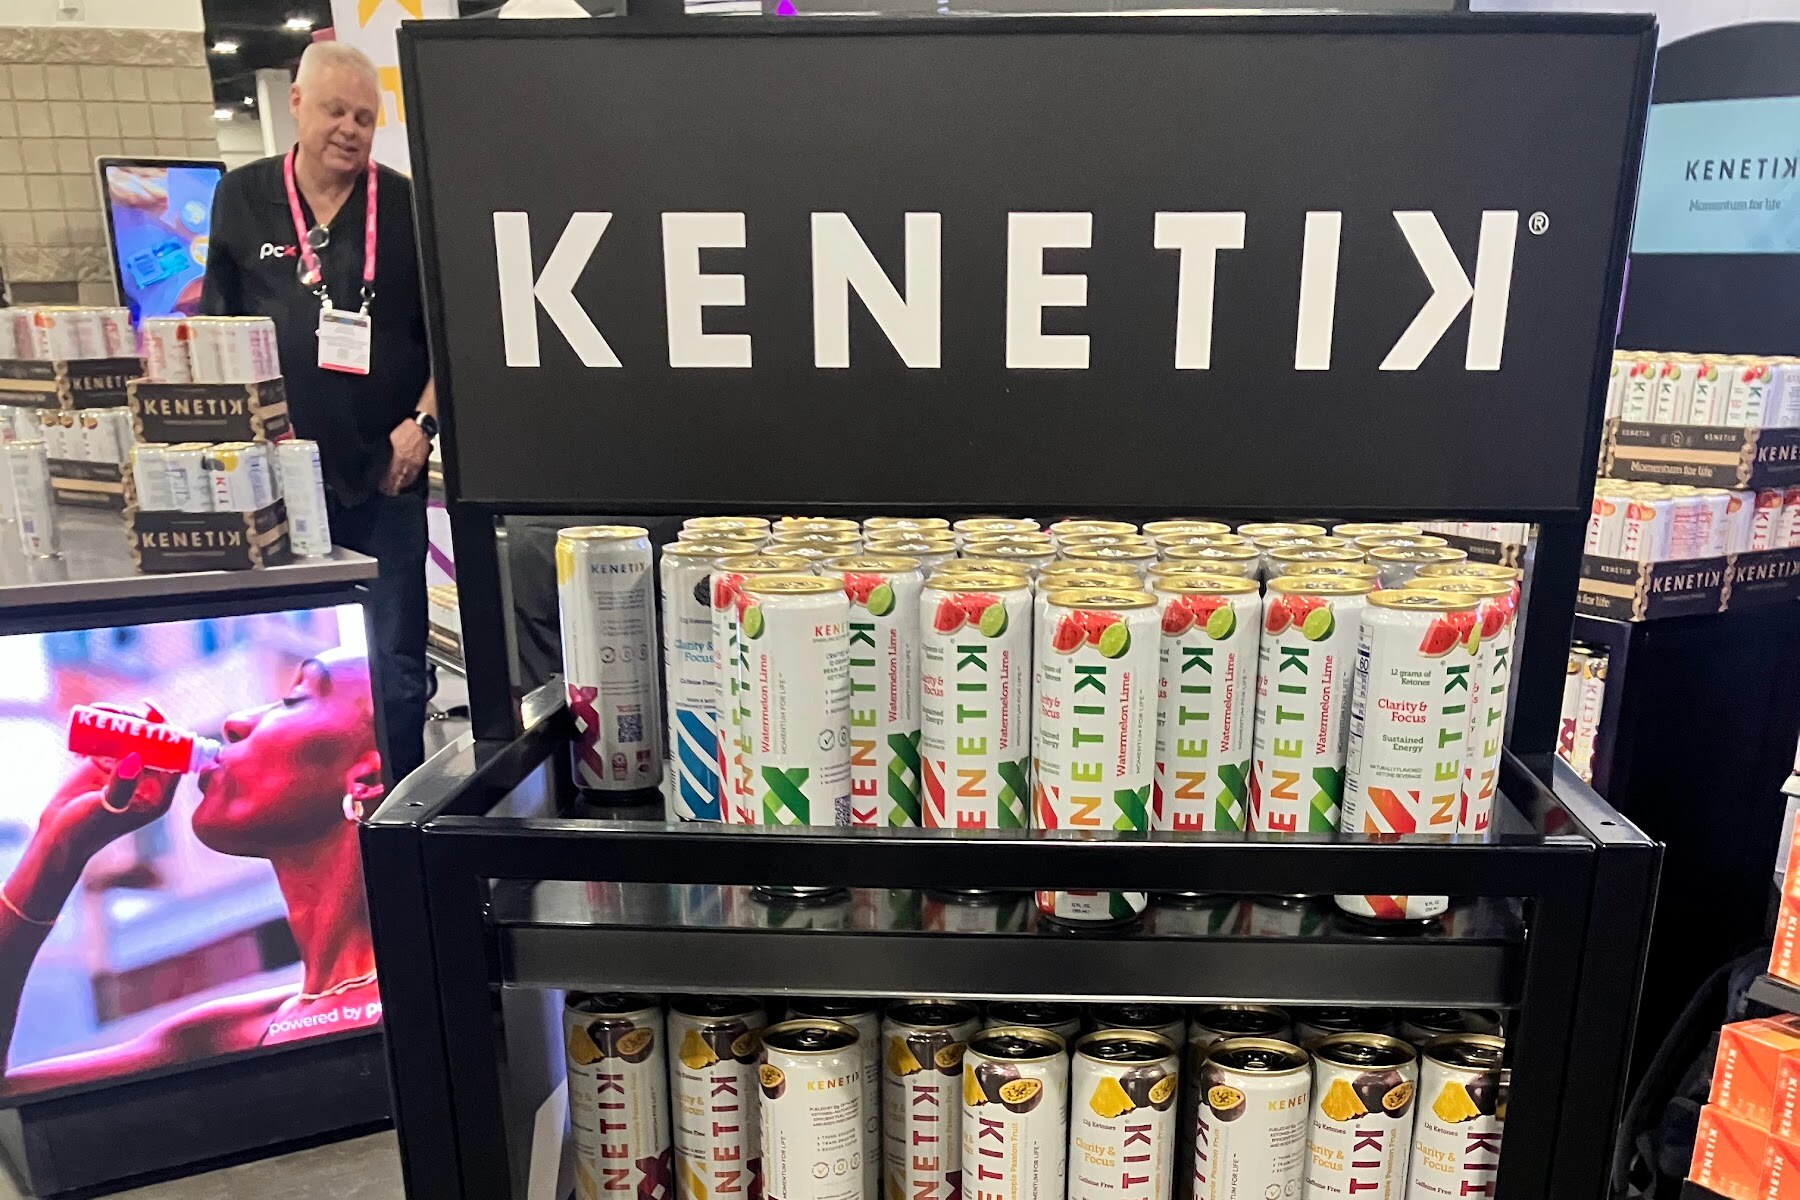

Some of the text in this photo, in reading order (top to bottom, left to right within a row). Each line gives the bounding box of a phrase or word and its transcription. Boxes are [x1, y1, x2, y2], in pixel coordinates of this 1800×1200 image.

[1750, 199, 1762, 210] for
[1765, 198, 1781, 210] life
[144, 400, 243, 415] KENETIK
[1631, 461, 1713, 477] Momentum for life
[142, 531, 241, 548] KENETIK
[1653, 571, 1720, 593] KENETIK
[684, 651, 715, 663] Focus
[888, 628, 897, 723] Watermelon Lime
[1400, 670, 1422, 678] grams
[1401, 678, 1430, 686] Ketones
[760, 654, 770, 752] Watermelon Lime
[1000, 650, 1009, 750] Watermelon Lime
[1221, 653, 1235, 753] Watermelon Lime
[1316, 655, 1333, 755] Watermelon Lime
[1378, 699, 1427, 713] Clarity &
[77, 711, 183, 745] KENETIK
[850, 623, 877, 827] KENETIK
[1116, 672, 1130, 777] Watermelon Lime
[1392, 712, 1426, 723] Focus
[957, 645, 987, 829] ENETIK
[1070, 665, 1107, 826] NETIK
[1173, 647, 1213, 831] ENETIK
[1268, 646, 1309, 832] ENETIK
[1382, 735, 1423, 744] Sustained
[1430, 665, 1470, 825] NETIK
[1393, 744, 1423, 754] Energy
[1778, 915, 1797, 976] KENETIK
[269, 1008, 338, 1036] powered
[343, 1006, 362, 1020] by
[1719, 1048, 1737, 1107] KENETIK
[1780, 1077, 1798, 1136] KENETIK
[1011, 1123, 1019, 1144] Fruit
[1424, 1122, 1458, 1136] 12g Ketones
[1076, 1137, 1116, 1156] Clarity &
[1416, 1141, 1456, 1162] Clarity &
[1701, 1128, 1718, 1185] KENETIK
[1010, 1146, 1018, 1173] Passion
[1085, 1153, 1115, 1167] Focus
[1313, 1154, 1343, 1171] Focus
[1423, 1157, 1455, 1174] Focus
[1416, 1179, 1452, 1196] Caffeine Free
